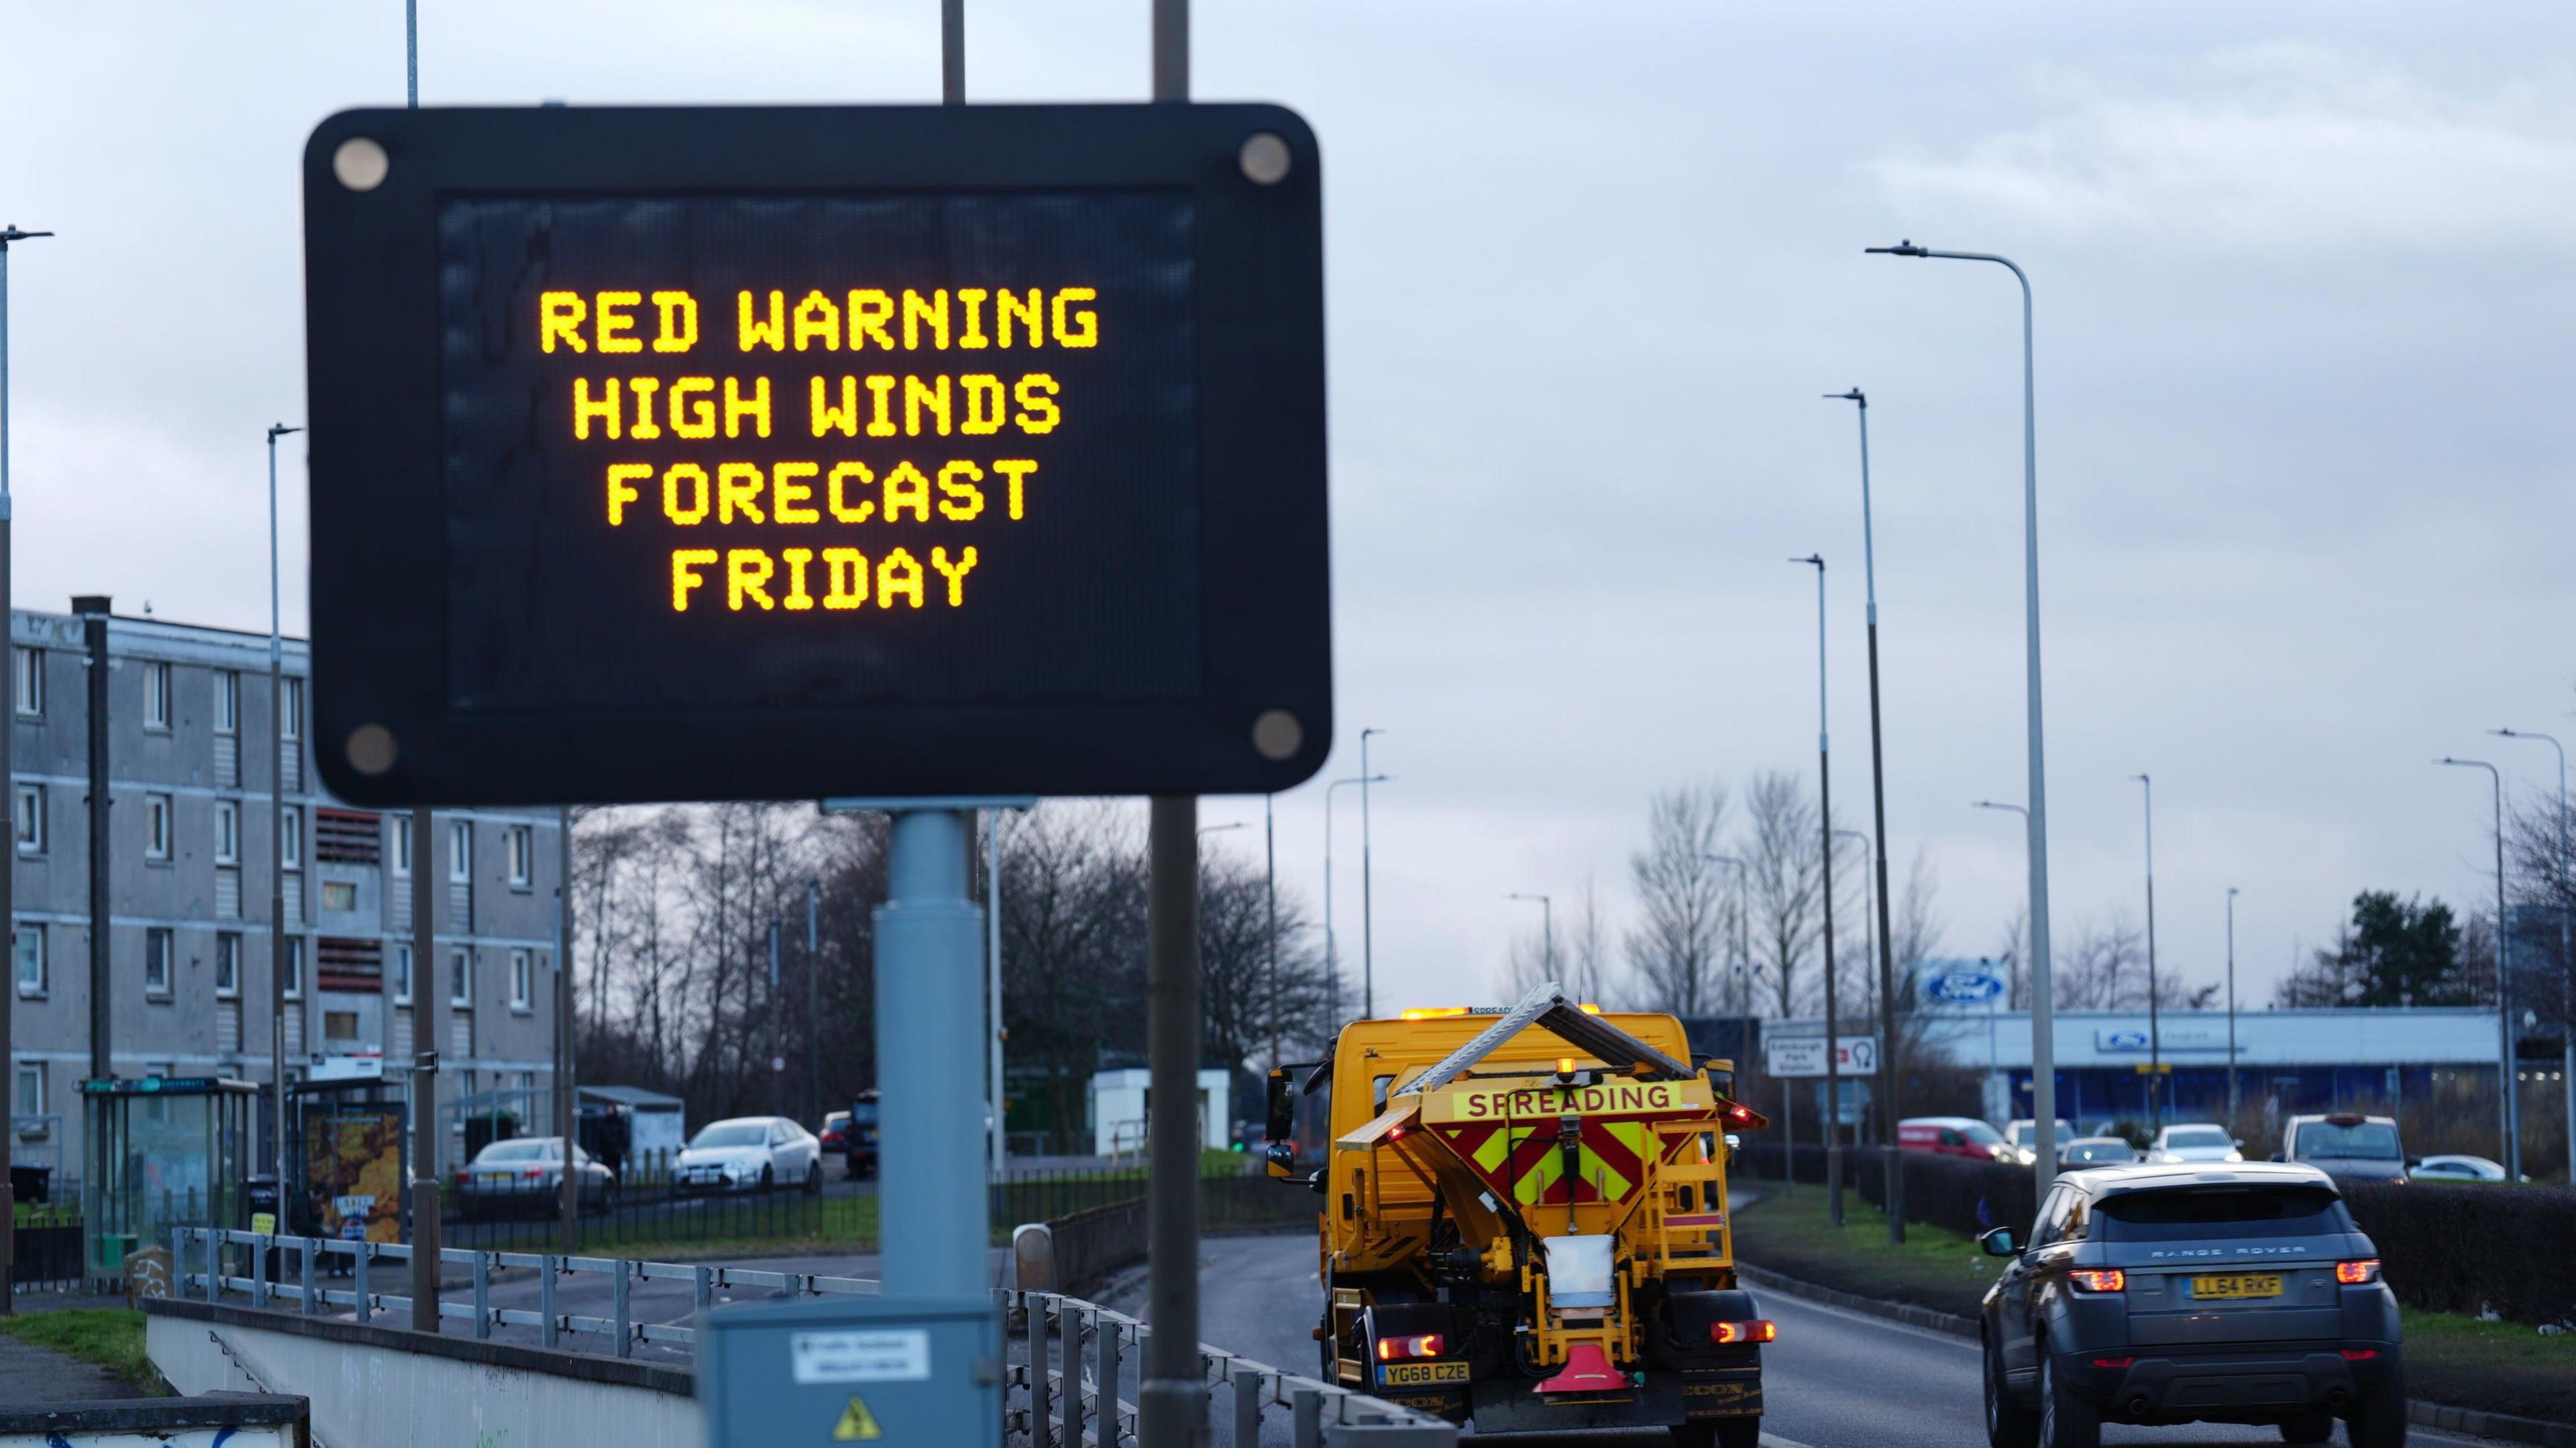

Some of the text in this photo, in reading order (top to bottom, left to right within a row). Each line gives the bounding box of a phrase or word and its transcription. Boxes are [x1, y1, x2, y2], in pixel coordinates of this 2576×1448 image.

[541, 288, 1097, 353] RED WARNING
[574, 374, 1060, 439] HIGH WINDS
[607, 459, 1038, 526] FORECAST
[672, 547, 977, 611] FRIDAY
[1935, 974, 1995, 1000] Ford
[1468, 1085, 1670, 1117] SPREADING
[2151, 1246, 2306, 1258] RANGE ROVER
[1389, 1365, 1466, 1382] YG68 CZE
